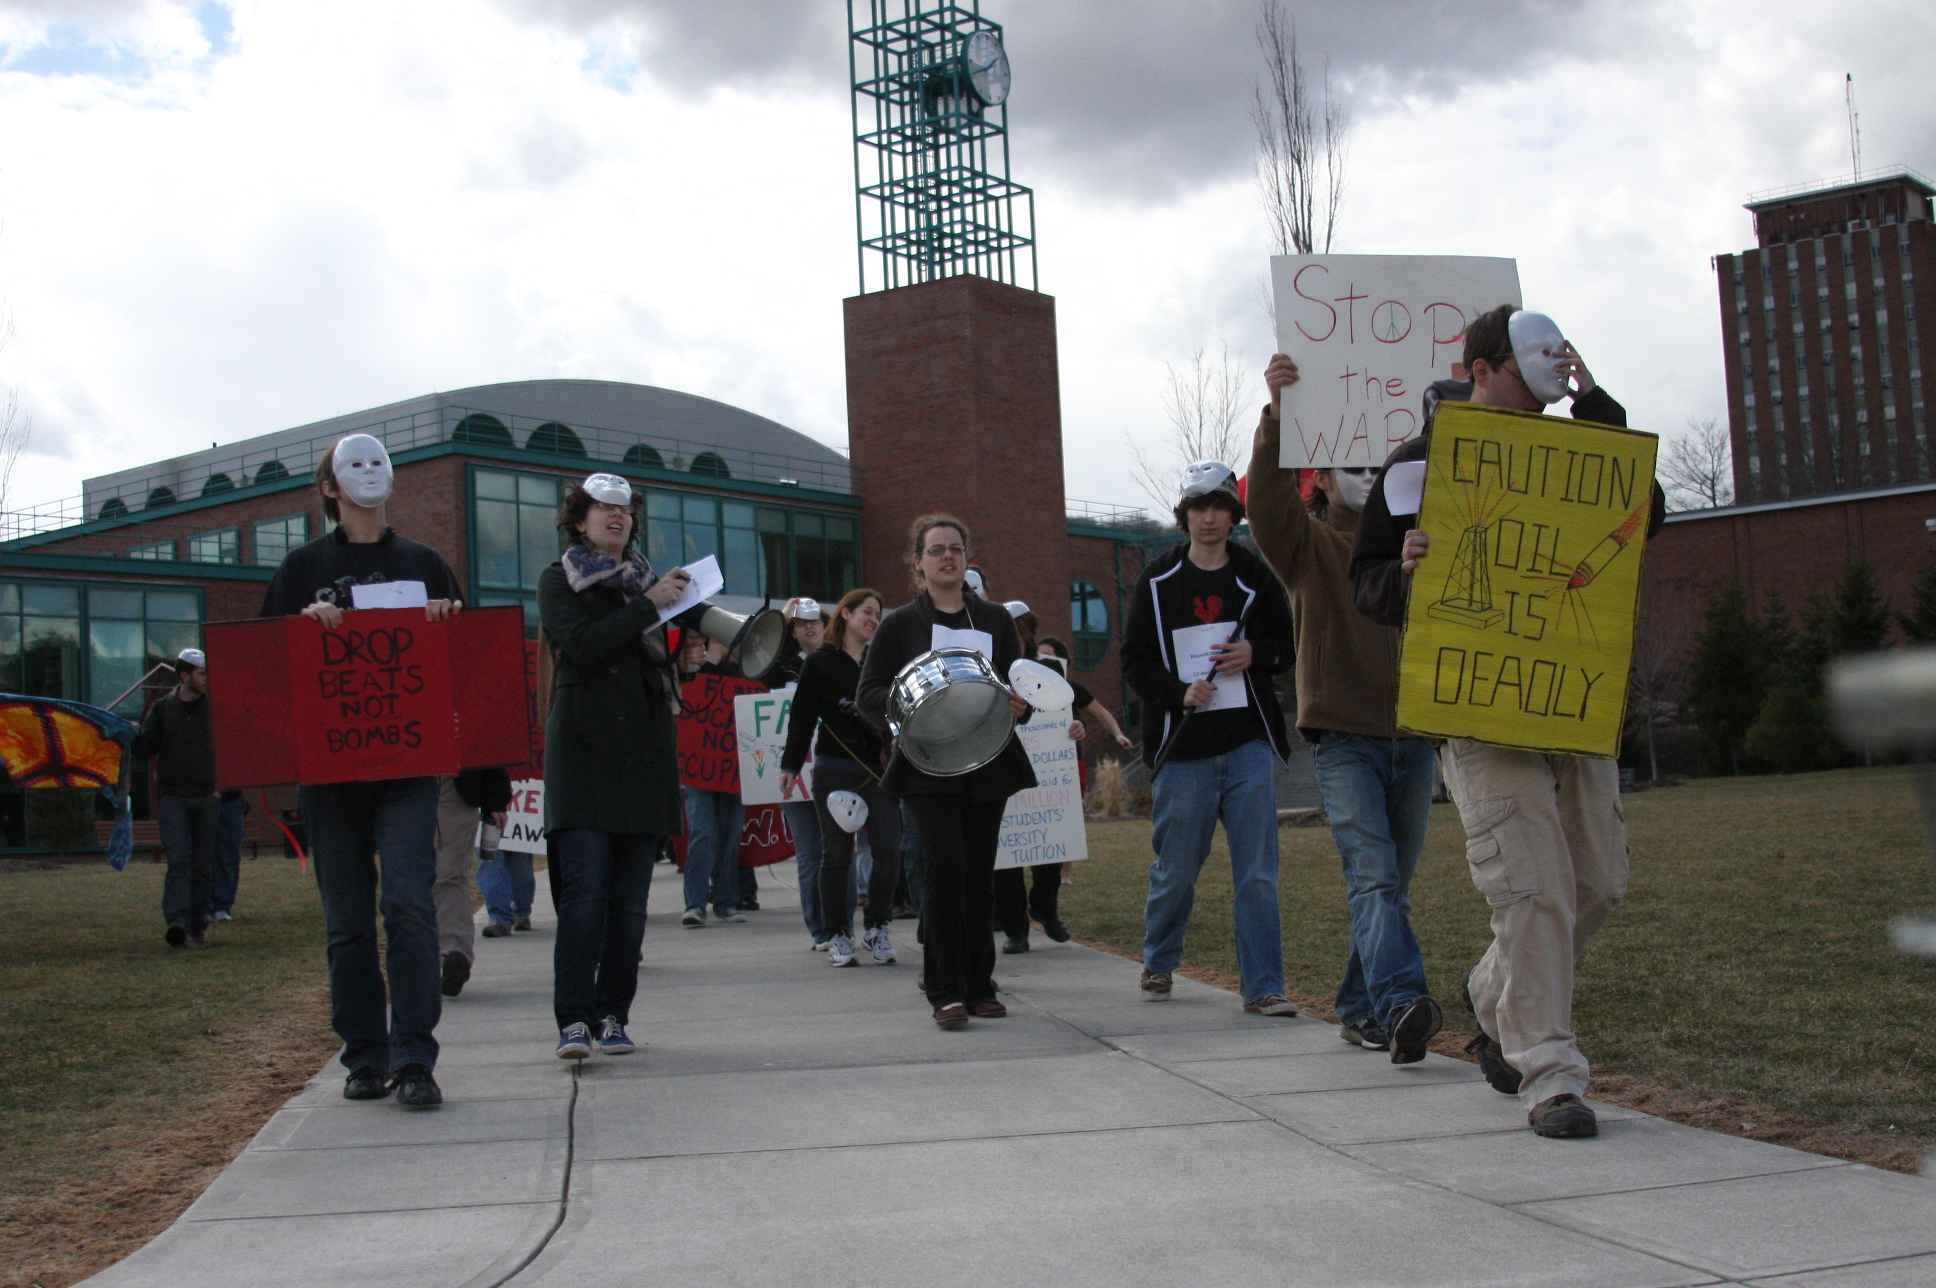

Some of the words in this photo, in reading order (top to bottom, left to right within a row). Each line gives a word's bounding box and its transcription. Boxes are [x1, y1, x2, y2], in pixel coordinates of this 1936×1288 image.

[1293, 264, 1466, 368] Stop
[1338, 364, 1406, 404] the
[1294, 408, 1416, 464] WAR
[1452, 437, 1636, 510] CAUTION
[1494, 518, 1571, 578] OIL
[1503, 590, 1547, 641] IS
[321, 626, 415, 666] DROP
[318, 665, 425, 700] BEATS
[1433, 646, 1604, 722] DEADLY
[340, 693, 399, 718] NOT
[326, 720, 422, 753] BOMBS
[1020, 720, 1058, 733] thousands
[1032, 747, 1075, 765] DOLLARS
[1013, 788, 1071, 810] MILLION
[1036, 776, 1058, 790] aid
[998, 828, 1048, 849] VERSITY
[1011, 843, 1066, 864] TUITION
